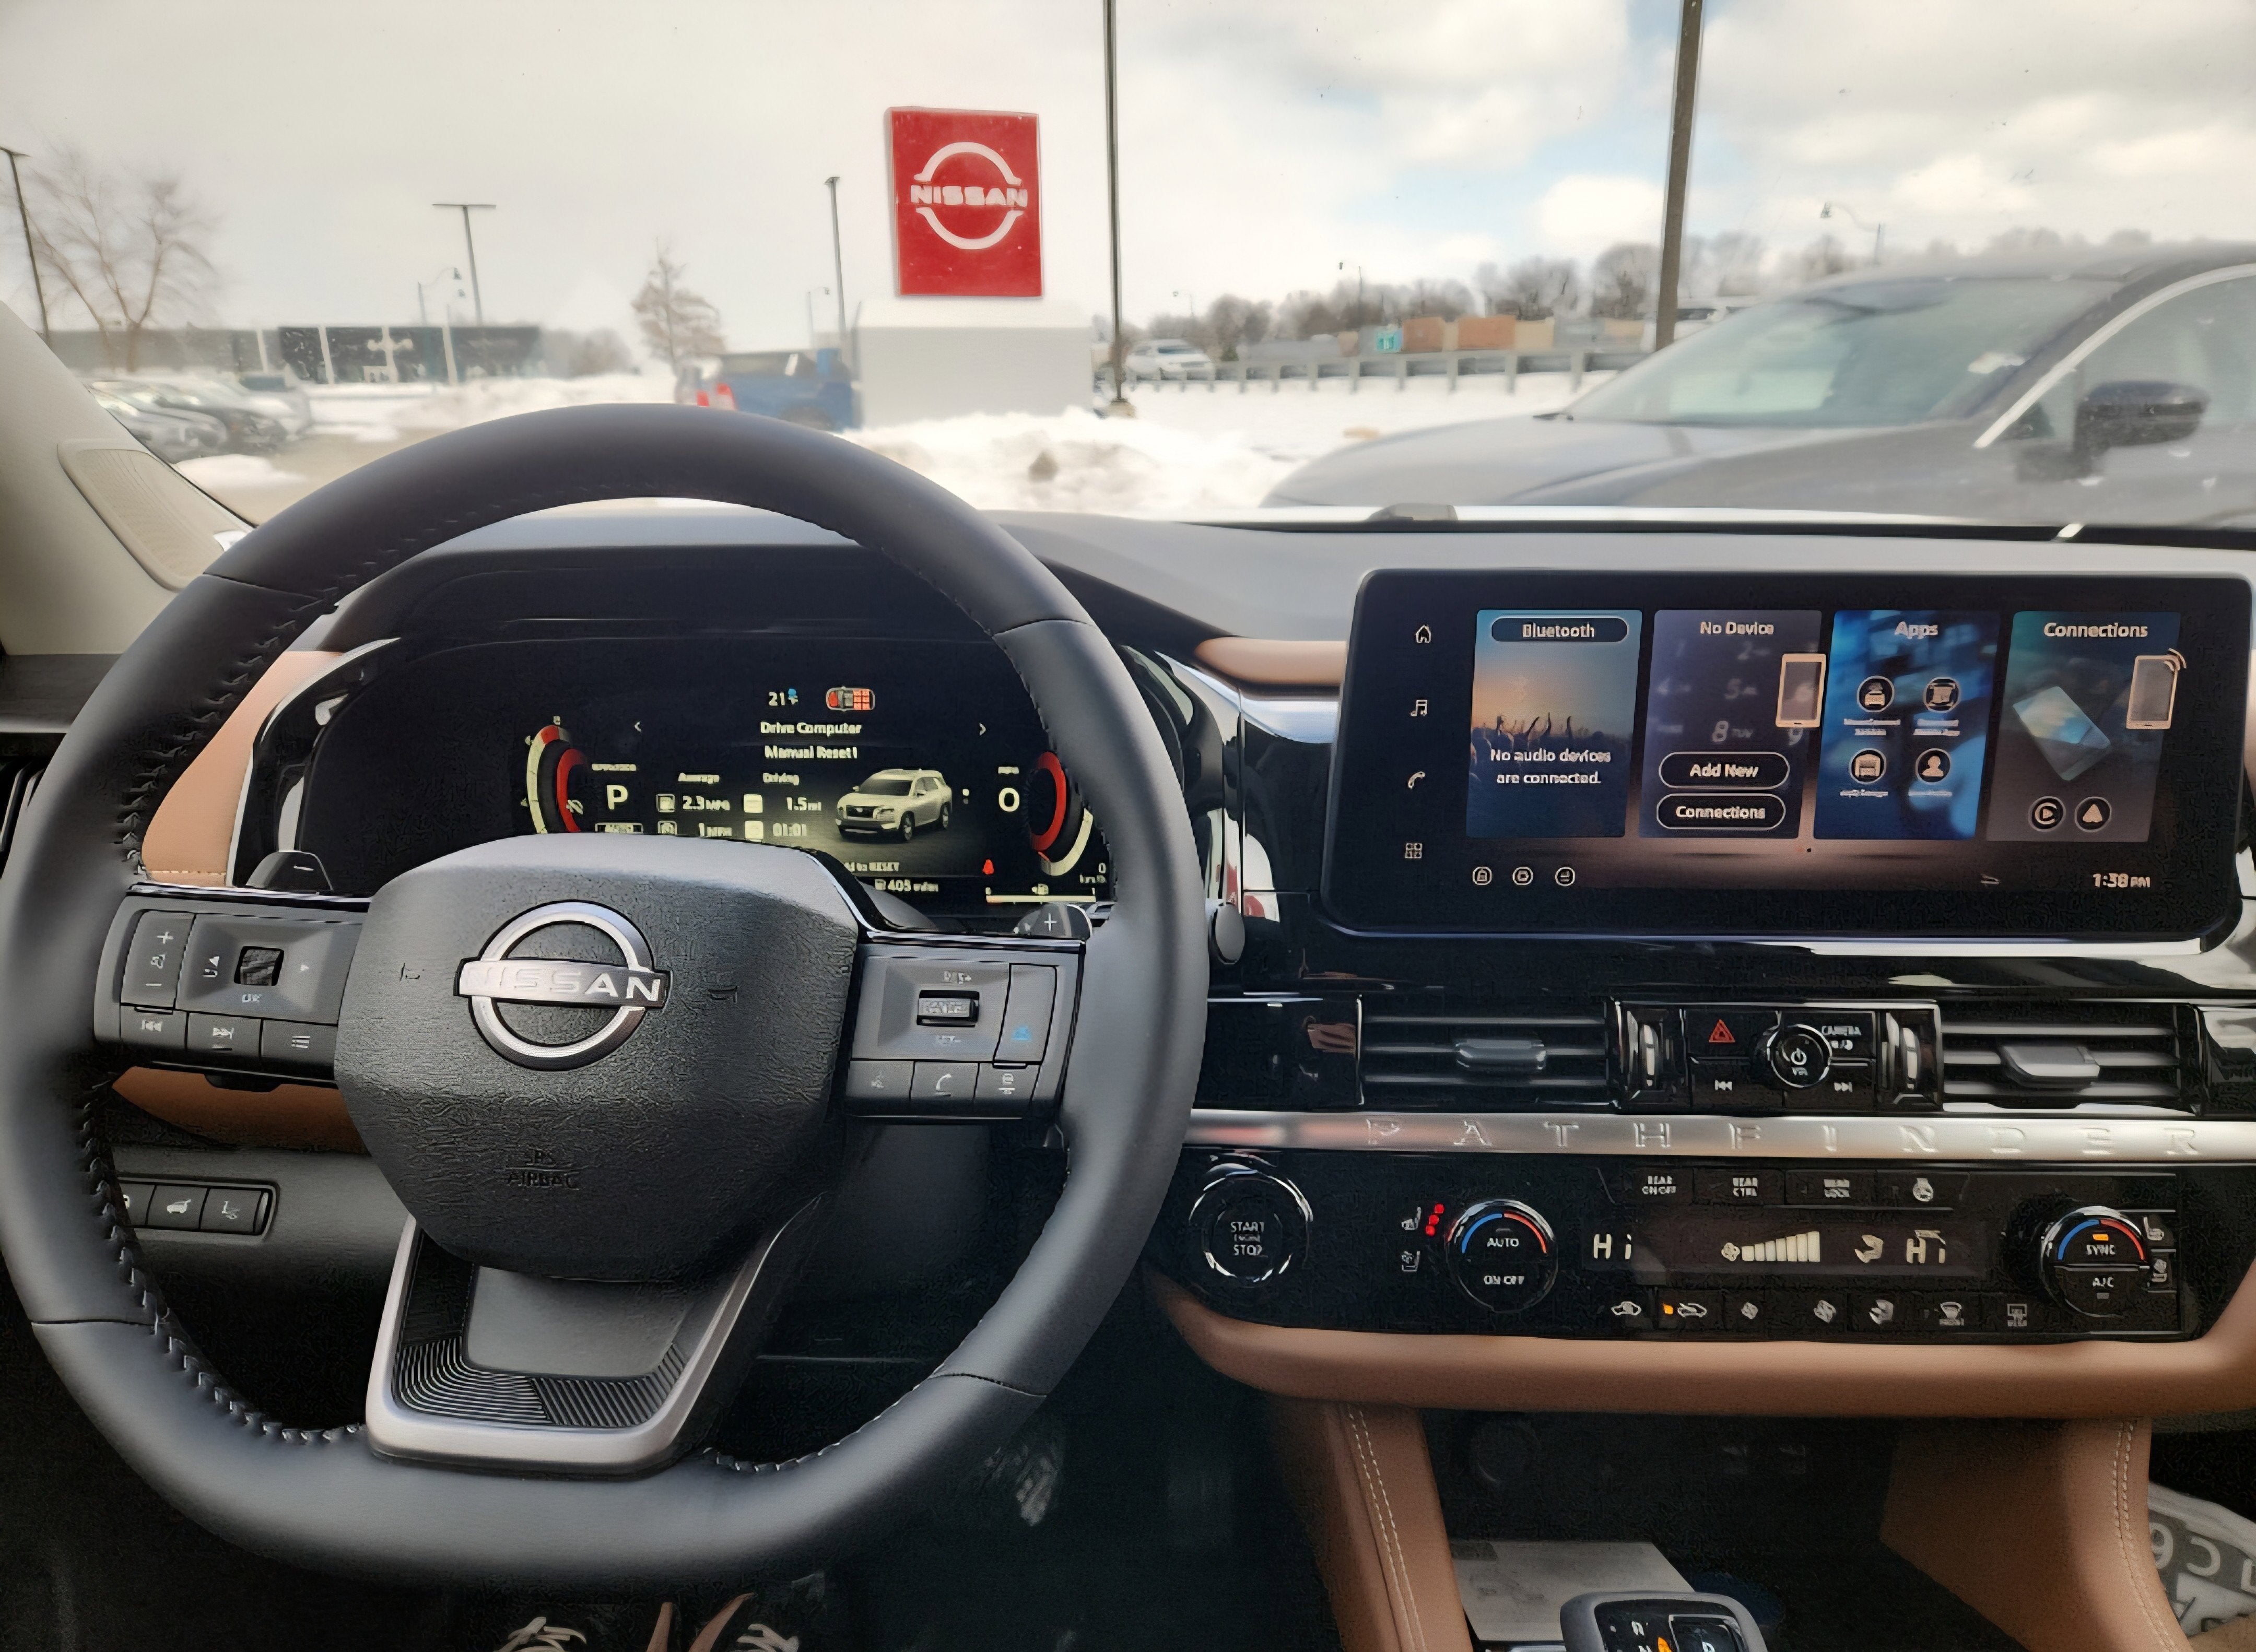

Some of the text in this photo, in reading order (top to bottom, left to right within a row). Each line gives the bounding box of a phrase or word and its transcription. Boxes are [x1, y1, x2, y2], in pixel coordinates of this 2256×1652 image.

[910, 184, 1028, 207] NISSAN
[1522, 622, 1595, 638] Bluetooth
[1700, 621, 1774, 635] No Device
[1894, 621, 1938, 639] Apps
[2043, 622, 2148, 638] Connections
[760, 722, 862, 737] Drive Computer
[765, 746, 814, 759] Manual
[1491, 748, 1611, 762] No audio devices
[1690, 763, 1759, 777] Add New
[1497, 775, 1520, 784] are
[607, 785, 628, 810] P
[1675, 806, 1765, 820] Connections
[1230, 1222, 1265, 1233] START
[1487, 1238, 1519, 1247] AUTO
[1233, 1244, 1263, 1256] STOP
